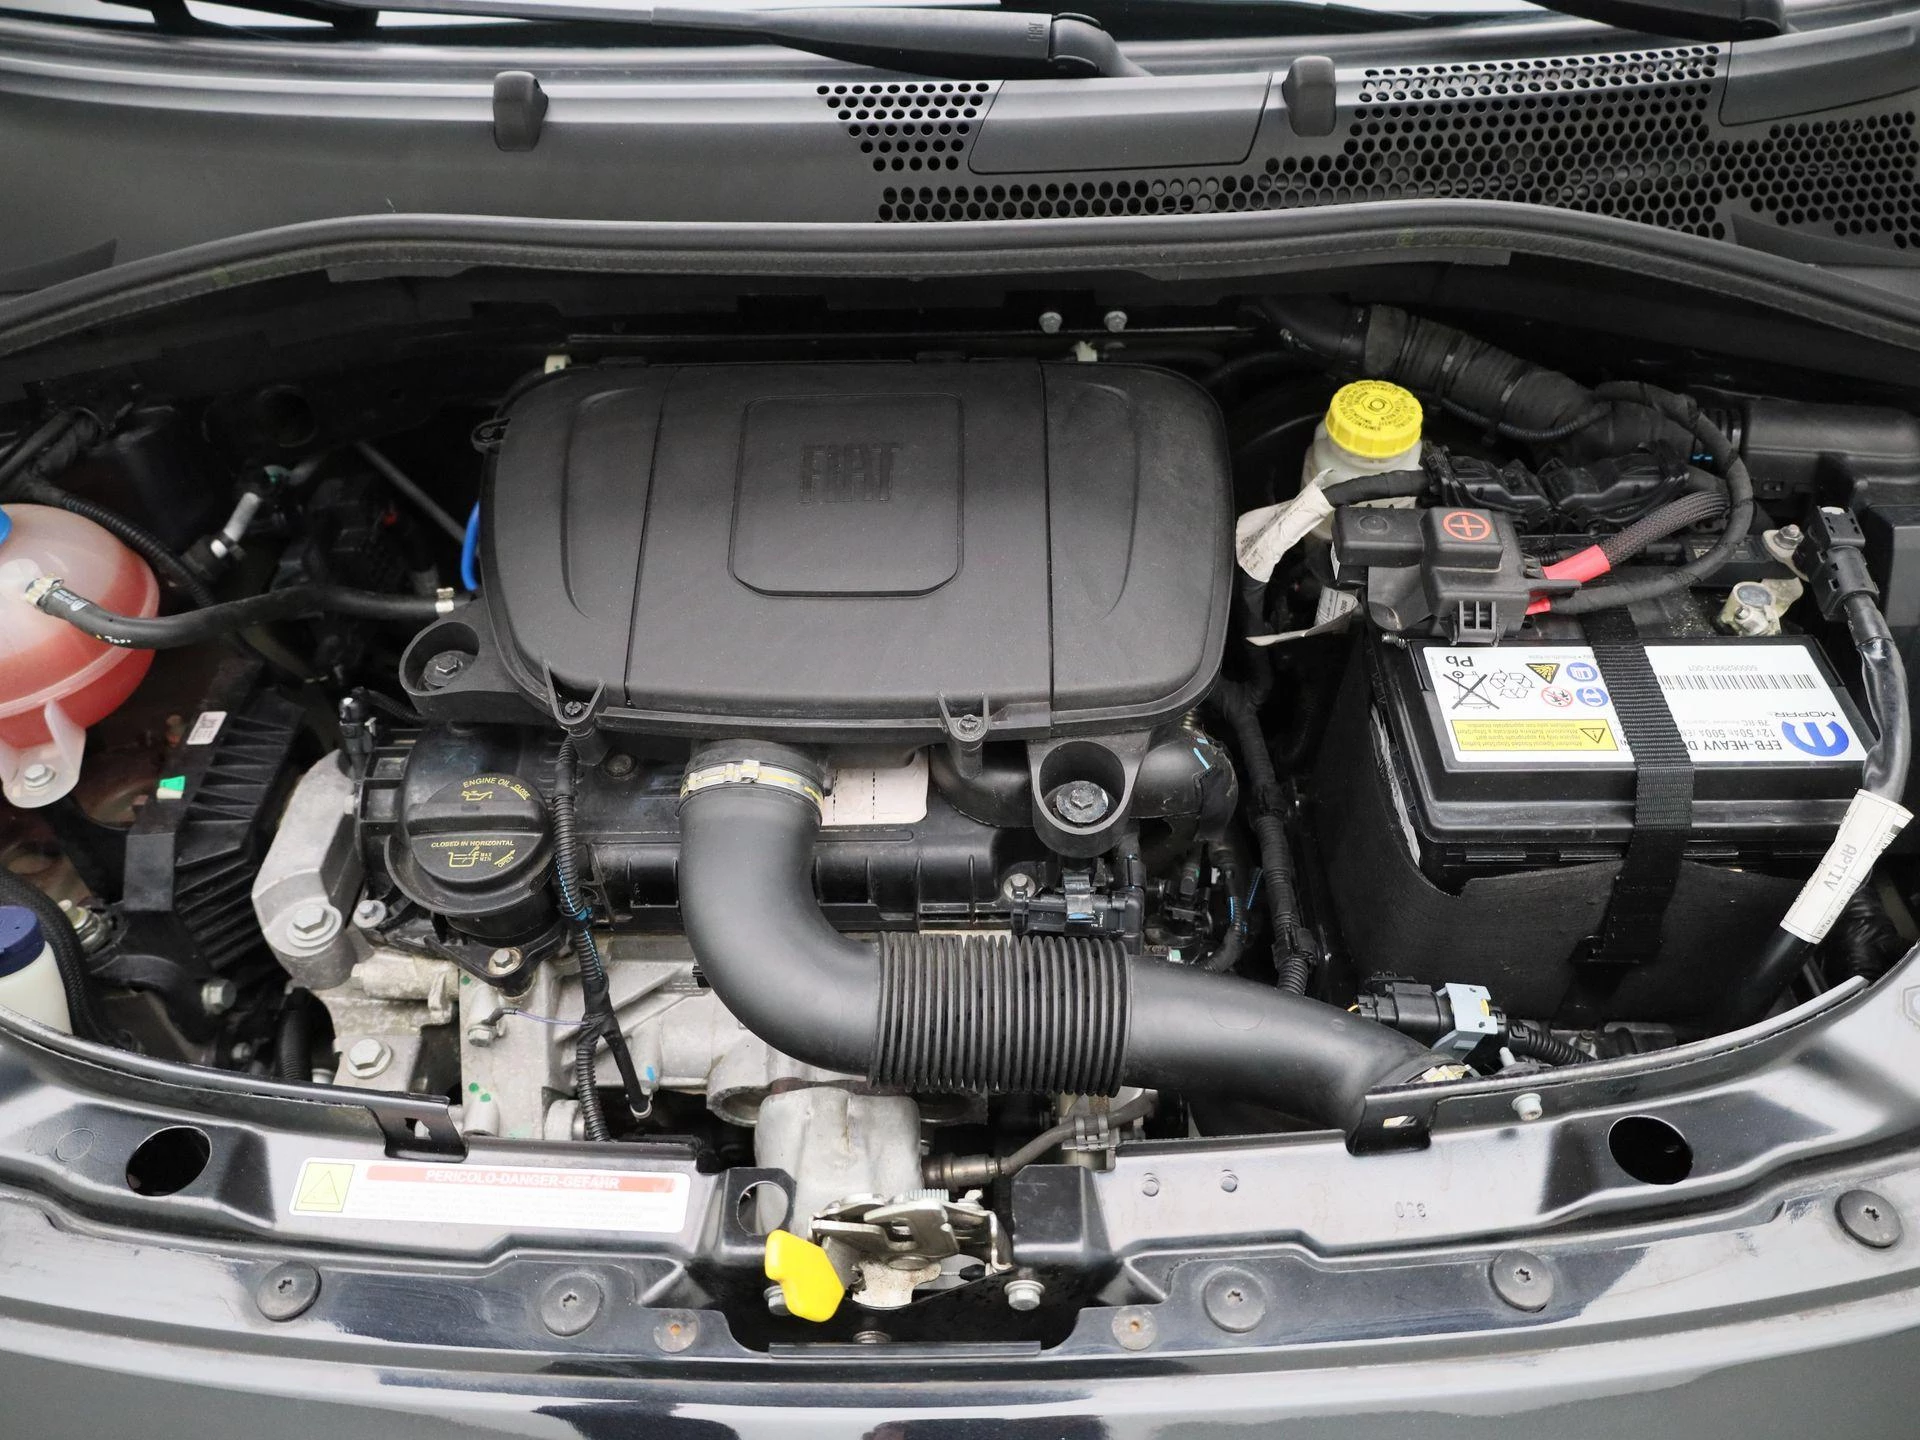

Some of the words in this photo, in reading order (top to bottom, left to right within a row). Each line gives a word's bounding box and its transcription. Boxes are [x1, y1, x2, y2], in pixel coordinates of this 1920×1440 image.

[799, 442, 904, 503] FIAT
[1445, 655, 1474, 667] Pb
[1704, 740, 1783, 751] EFB-HEAVY
[463, 777, 497, 788] ENGINE
[498, 778, 512, 788] OIL
[514, 784, 531, 797] CLOSE
[1824, 844, 1857, 891] APTIV
